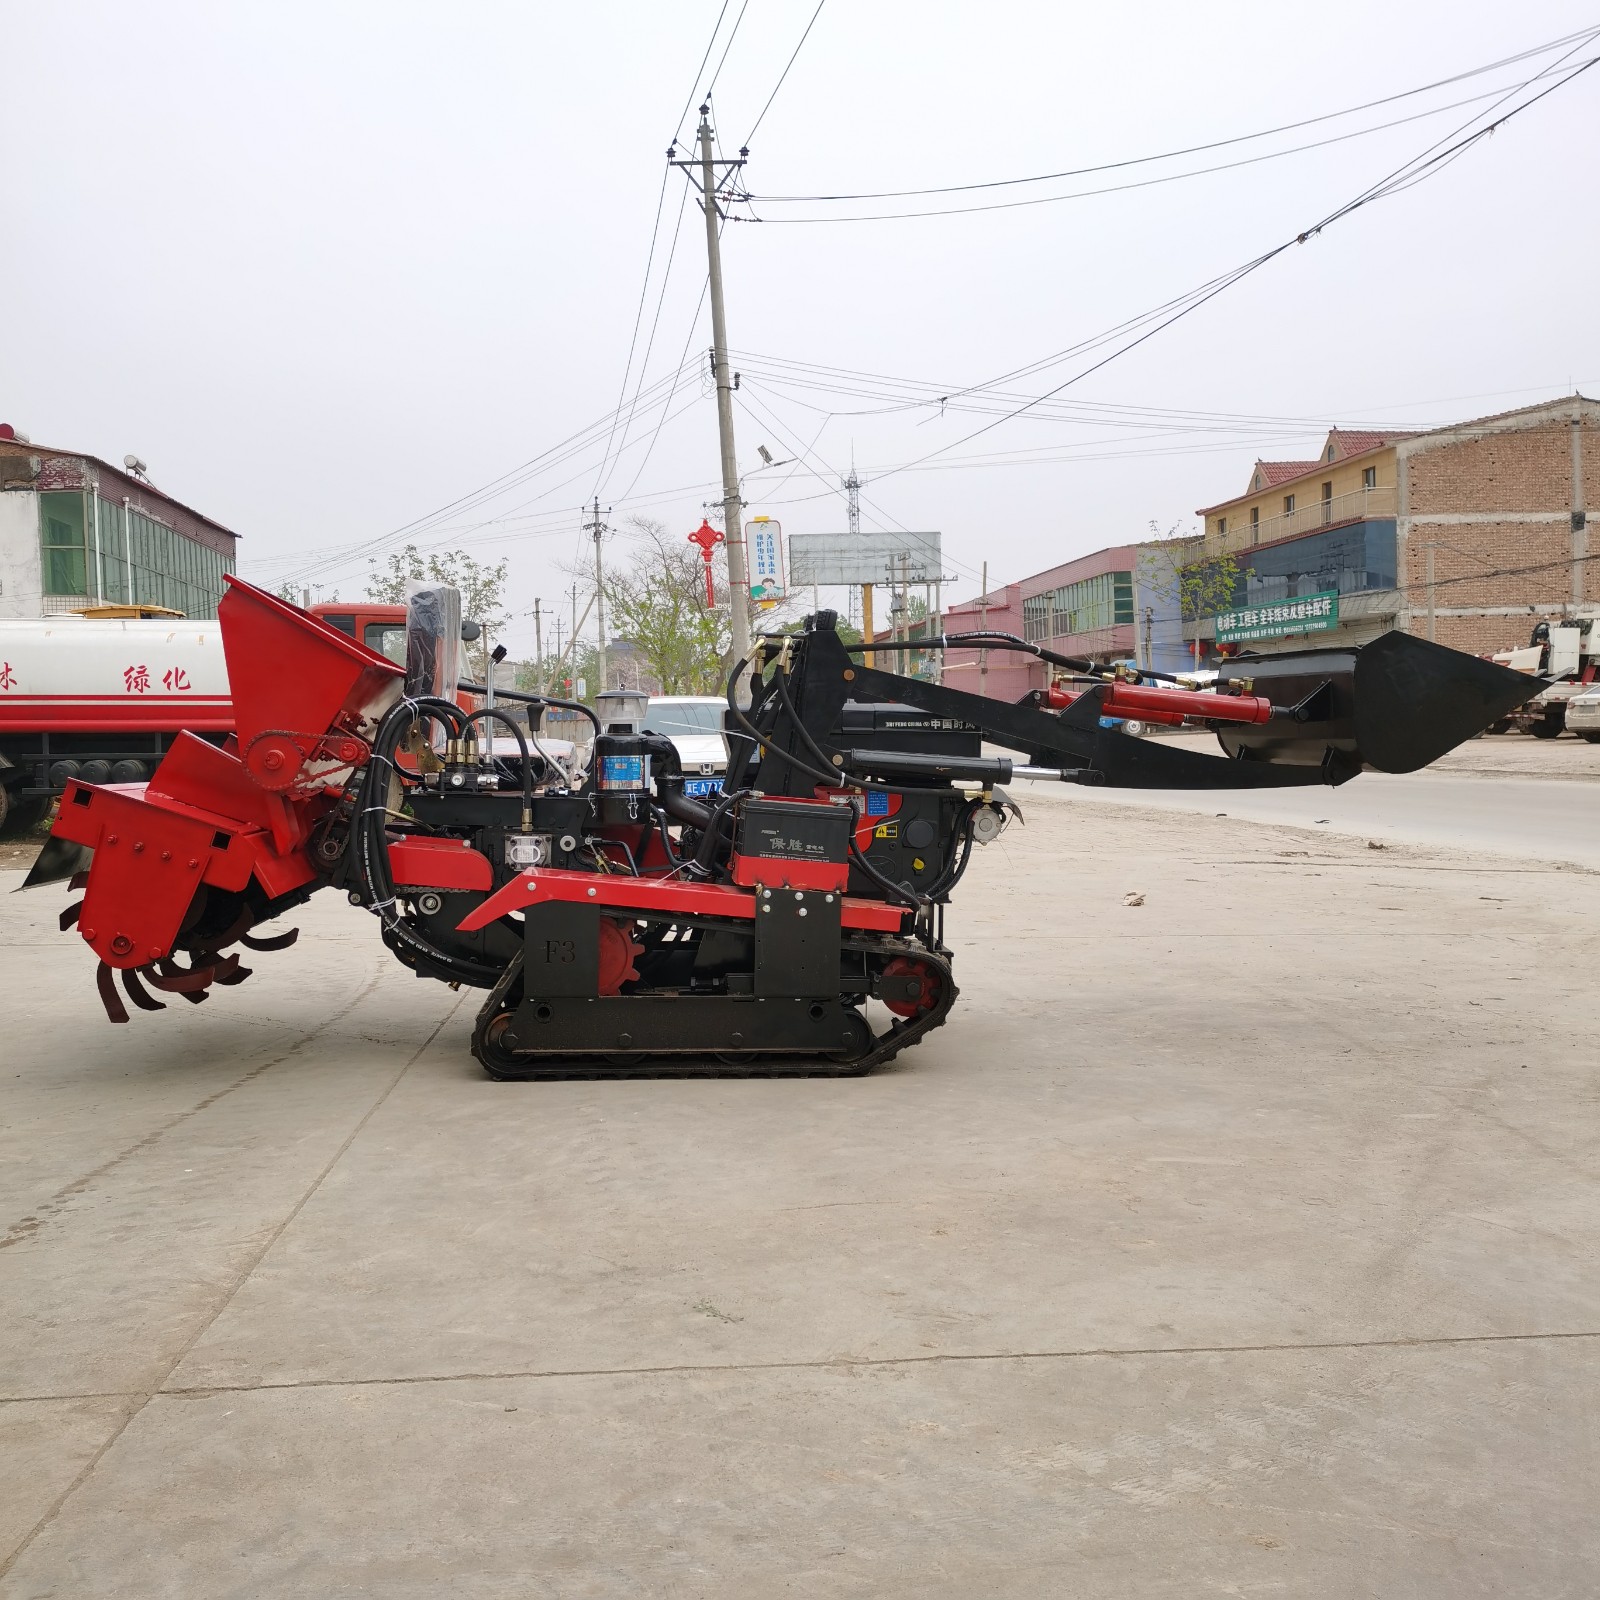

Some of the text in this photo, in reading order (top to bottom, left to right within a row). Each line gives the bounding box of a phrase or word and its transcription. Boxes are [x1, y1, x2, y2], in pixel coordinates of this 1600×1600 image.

[1217, 612, 1237, 632] 电动车
[123, 664, 192, 694] 绿化
[769, 837, 804, 852] 保胜
[543, 940, 576, 964] F3
